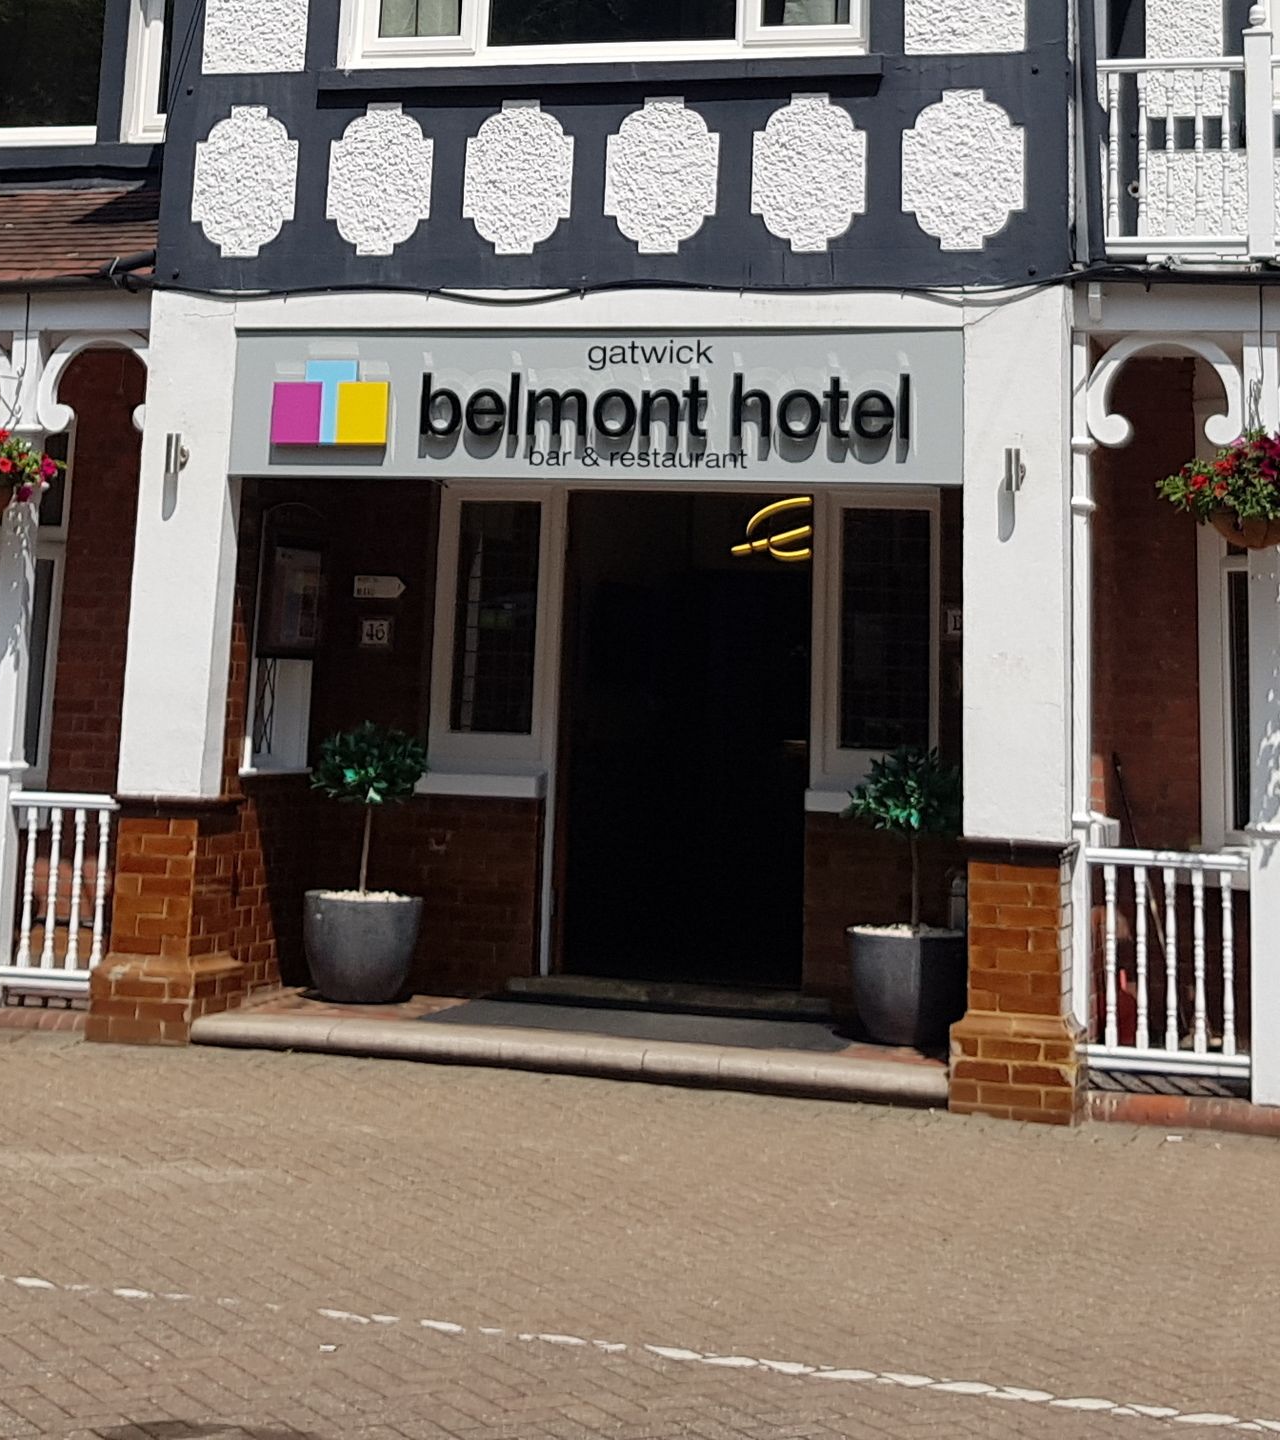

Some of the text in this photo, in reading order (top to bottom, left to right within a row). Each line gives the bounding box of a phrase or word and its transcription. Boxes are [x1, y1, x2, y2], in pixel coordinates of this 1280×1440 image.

[587, 339, 714, 369] gatwick
[420, 371, 911, 440] belmont hotel
[528, 445, 749, 471] bar & restaurant
[366, 624, 385, 640] 46
